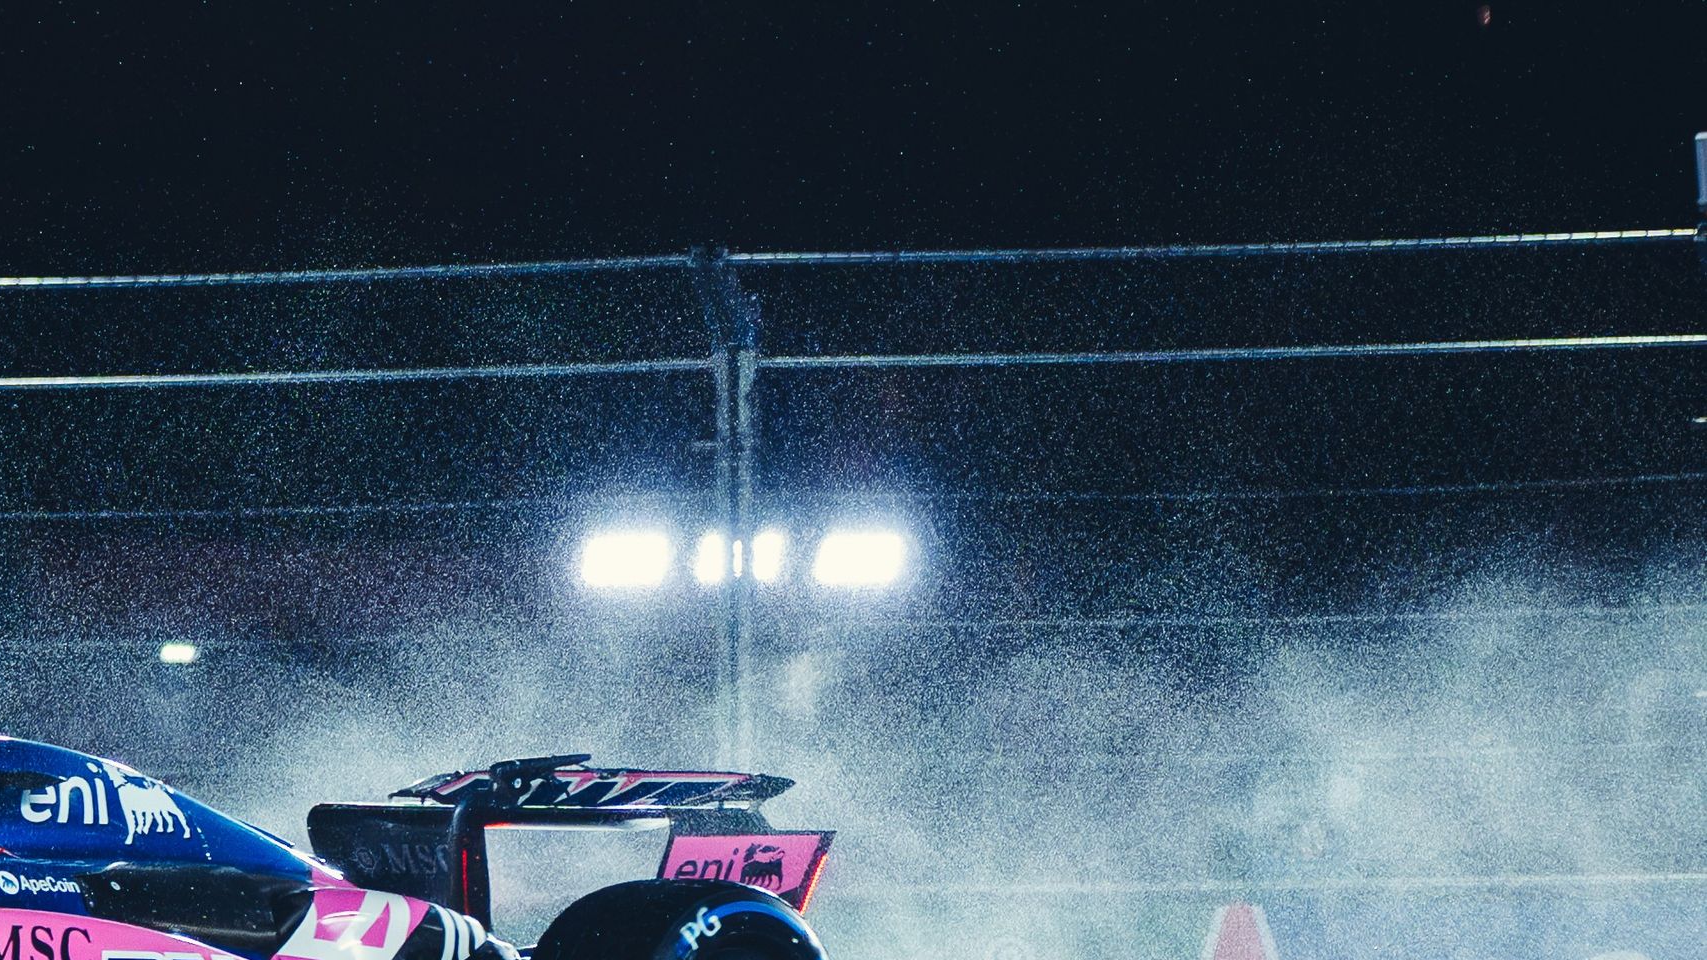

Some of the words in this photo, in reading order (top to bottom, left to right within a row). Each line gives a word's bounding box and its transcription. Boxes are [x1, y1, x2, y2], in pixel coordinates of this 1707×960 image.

[20, 762, 109, 825] eni
[674, 847, 740, 881] eni
[21, 874, 81, 894] ApeCoin
